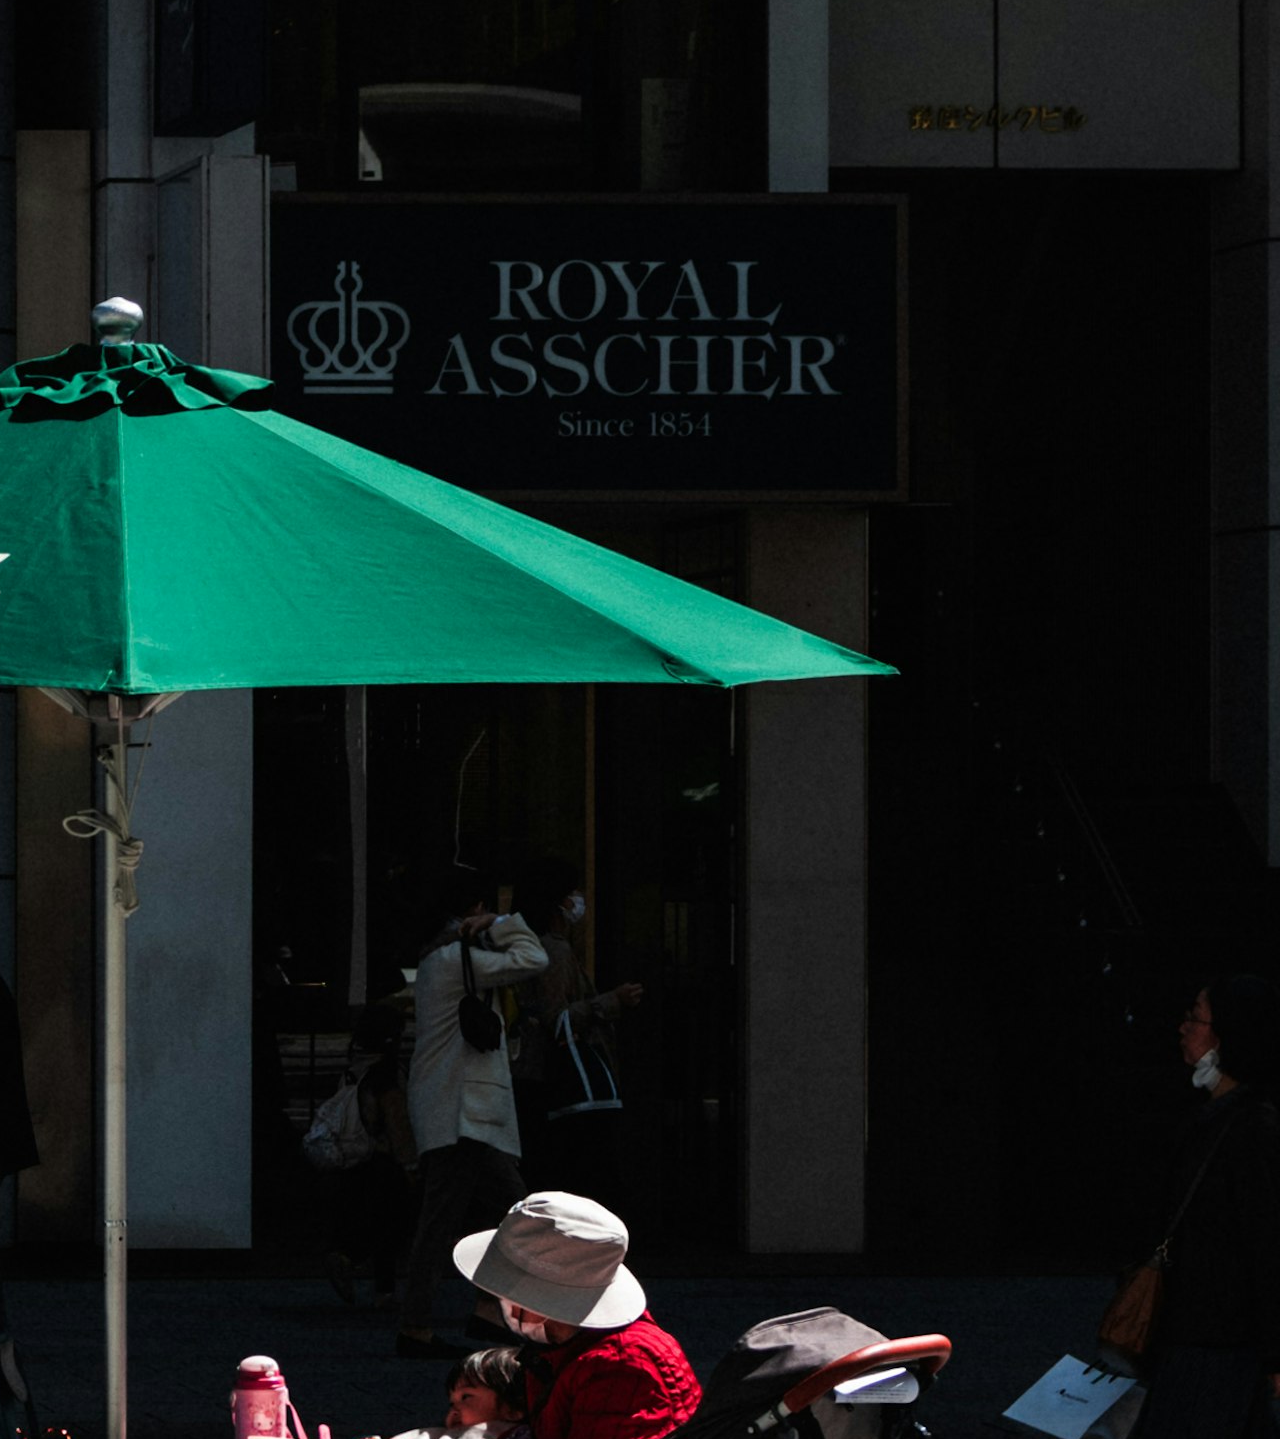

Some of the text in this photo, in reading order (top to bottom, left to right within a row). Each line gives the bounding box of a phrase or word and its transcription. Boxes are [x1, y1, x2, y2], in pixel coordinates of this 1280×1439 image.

[489, 259, 783, 327] ROYAL
[558, 411, 713, 438] Since 1854
